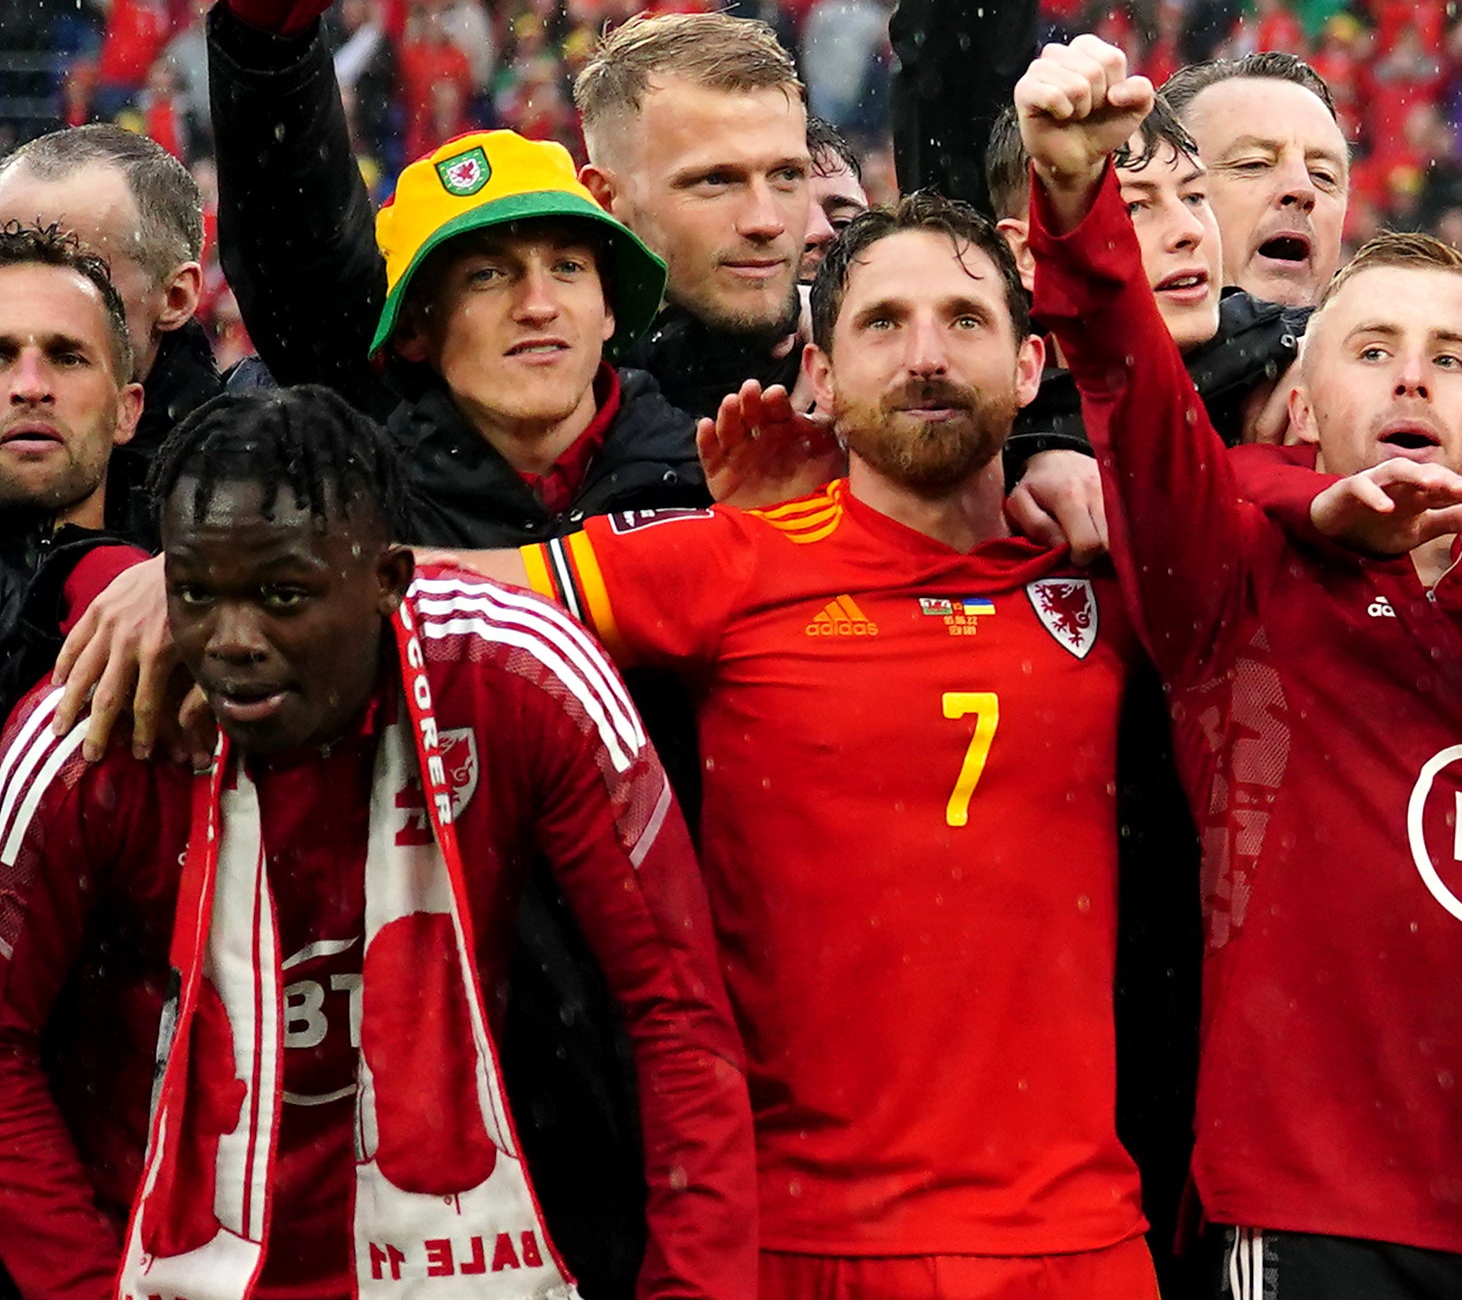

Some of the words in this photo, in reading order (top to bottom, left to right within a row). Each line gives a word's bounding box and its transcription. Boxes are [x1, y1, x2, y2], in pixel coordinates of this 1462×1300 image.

[805, 621, 879, 636] adidas
[942, 692, 999, 826] 7
[283, 973, 363, 1048] BT
